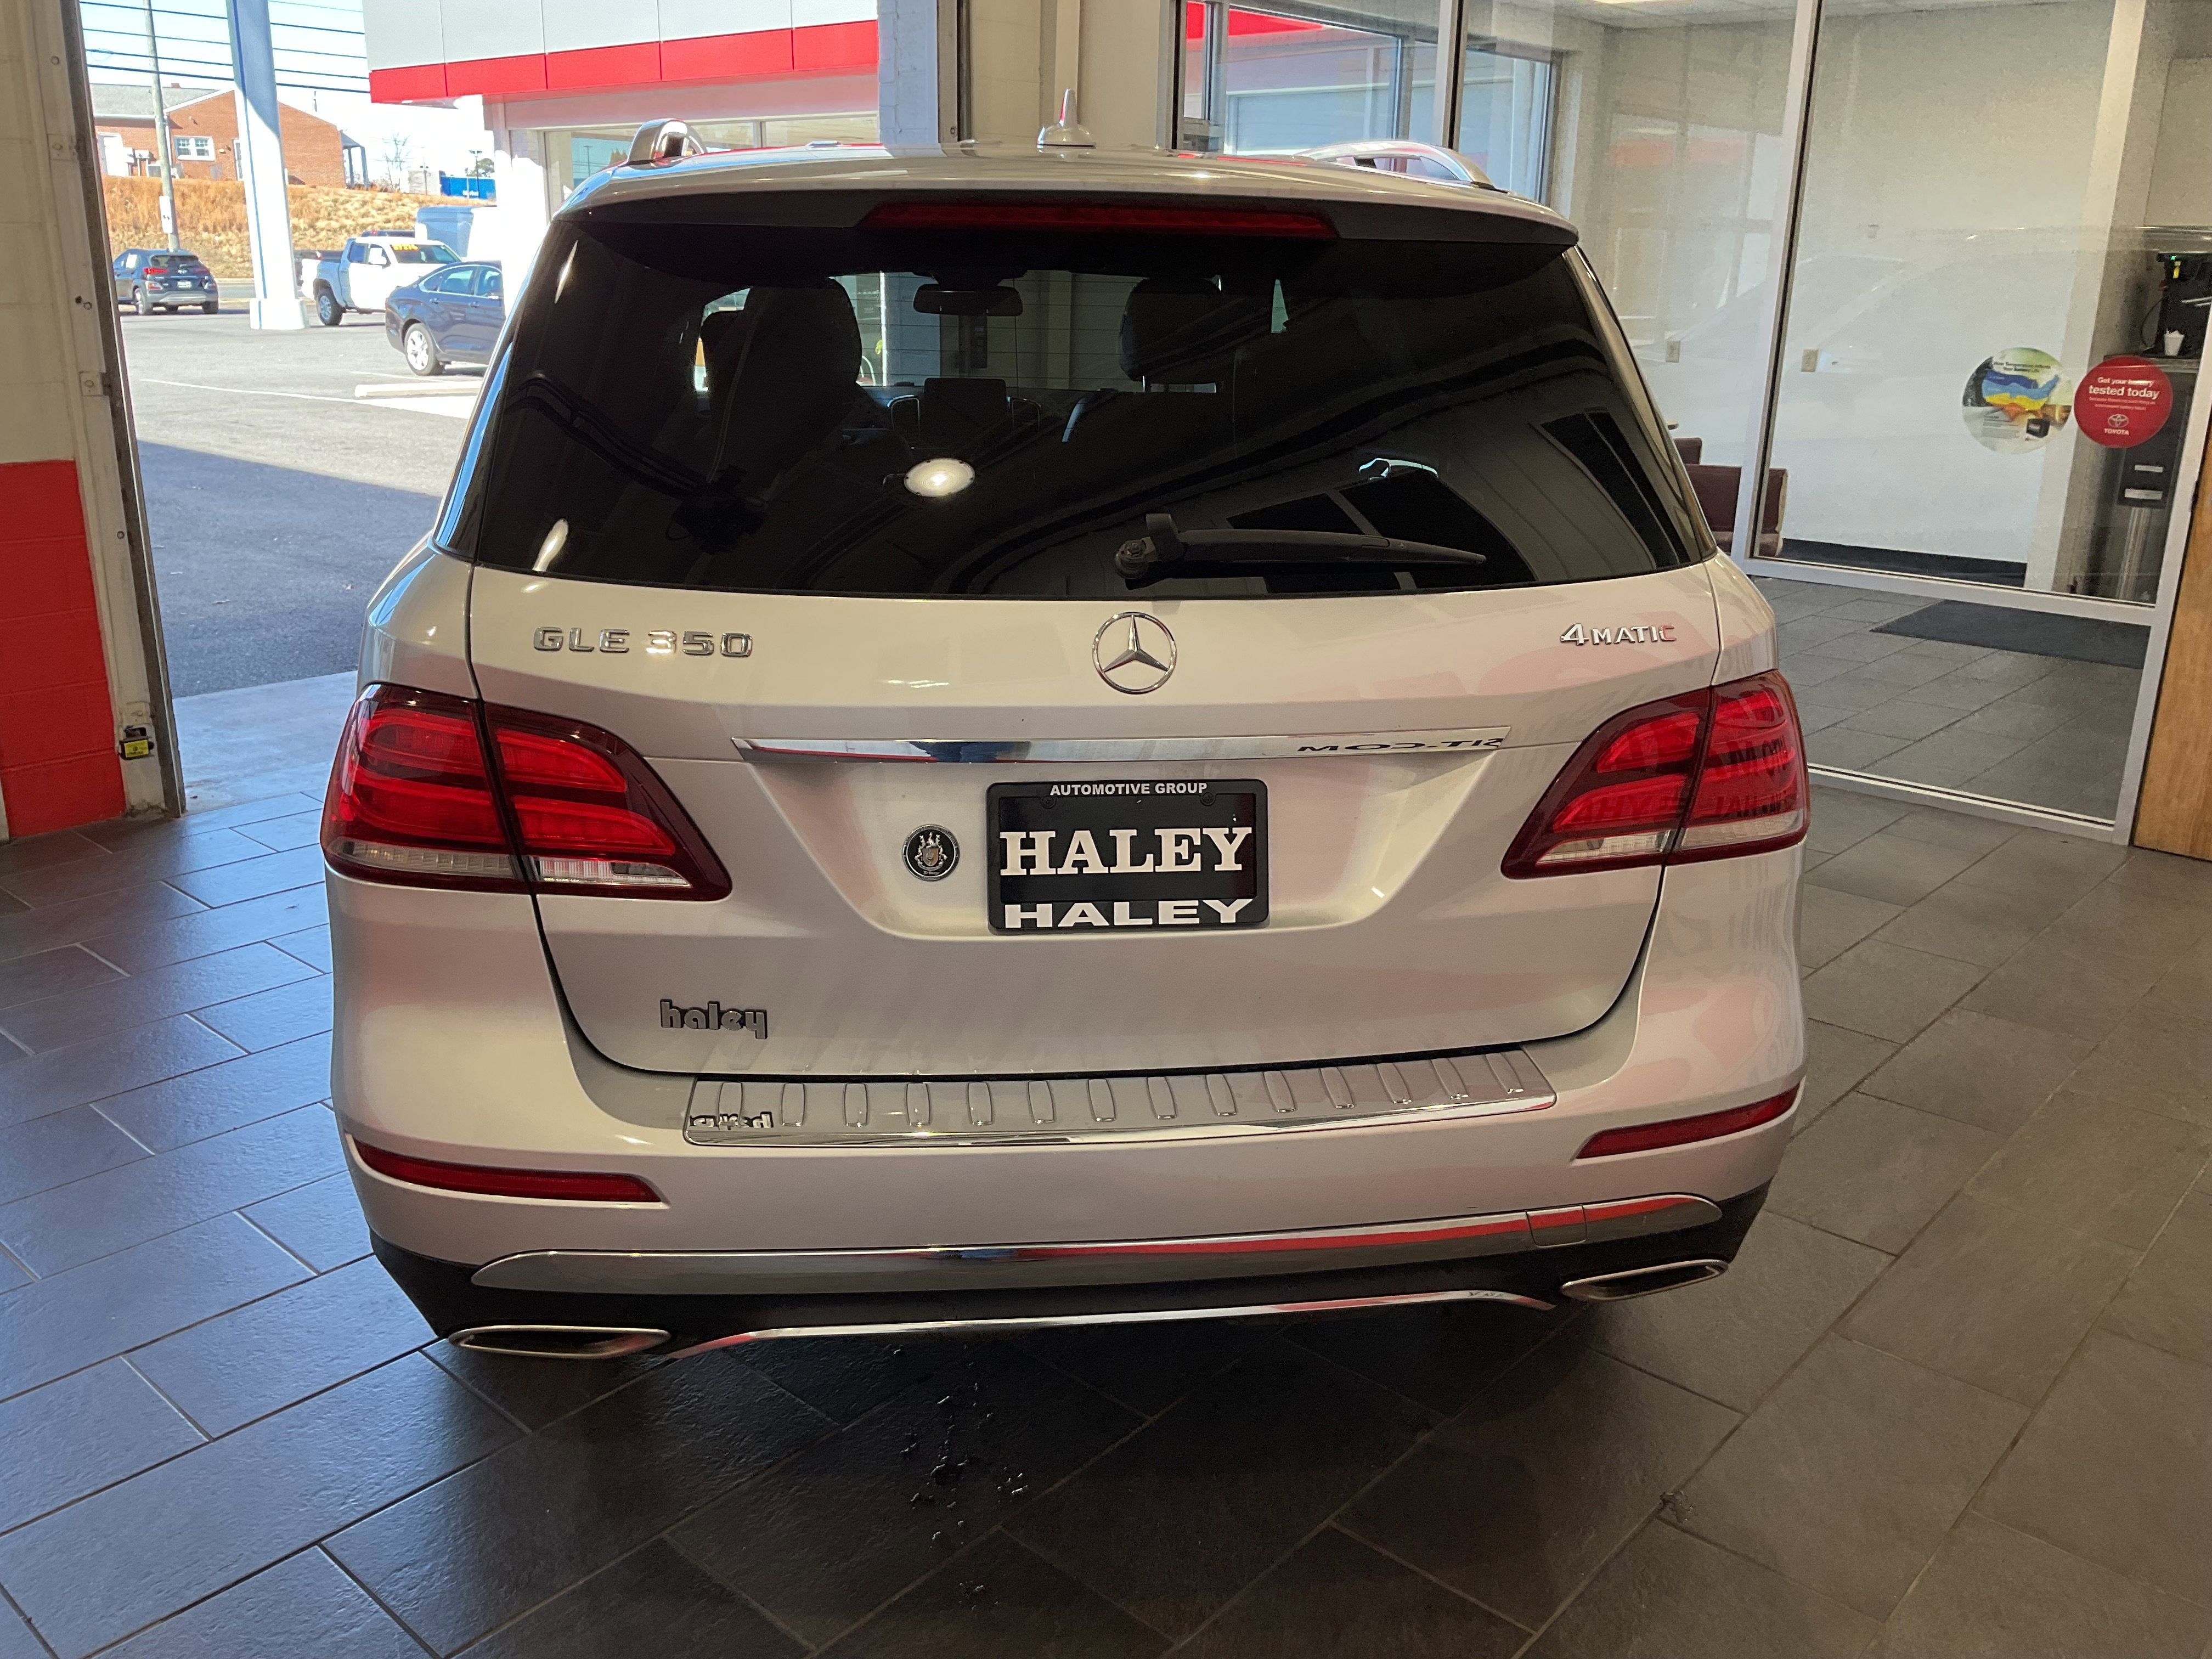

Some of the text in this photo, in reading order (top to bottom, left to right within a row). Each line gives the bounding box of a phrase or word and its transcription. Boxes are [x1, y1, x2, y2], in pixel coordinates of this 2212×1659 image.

[2089, 385, 2160, 400] tested today
[533, 626, 753, 658] GLE 350
[1559, 623, 1677, 646] 4MATIC
[1050, 782, 1207, 795] AUTOMOTIVE GROUP
[1000, 827, 1252, 876] HALEY
[1005, 899, 1254, 928] HALEY
[660, 999, 768, 1039] haley
